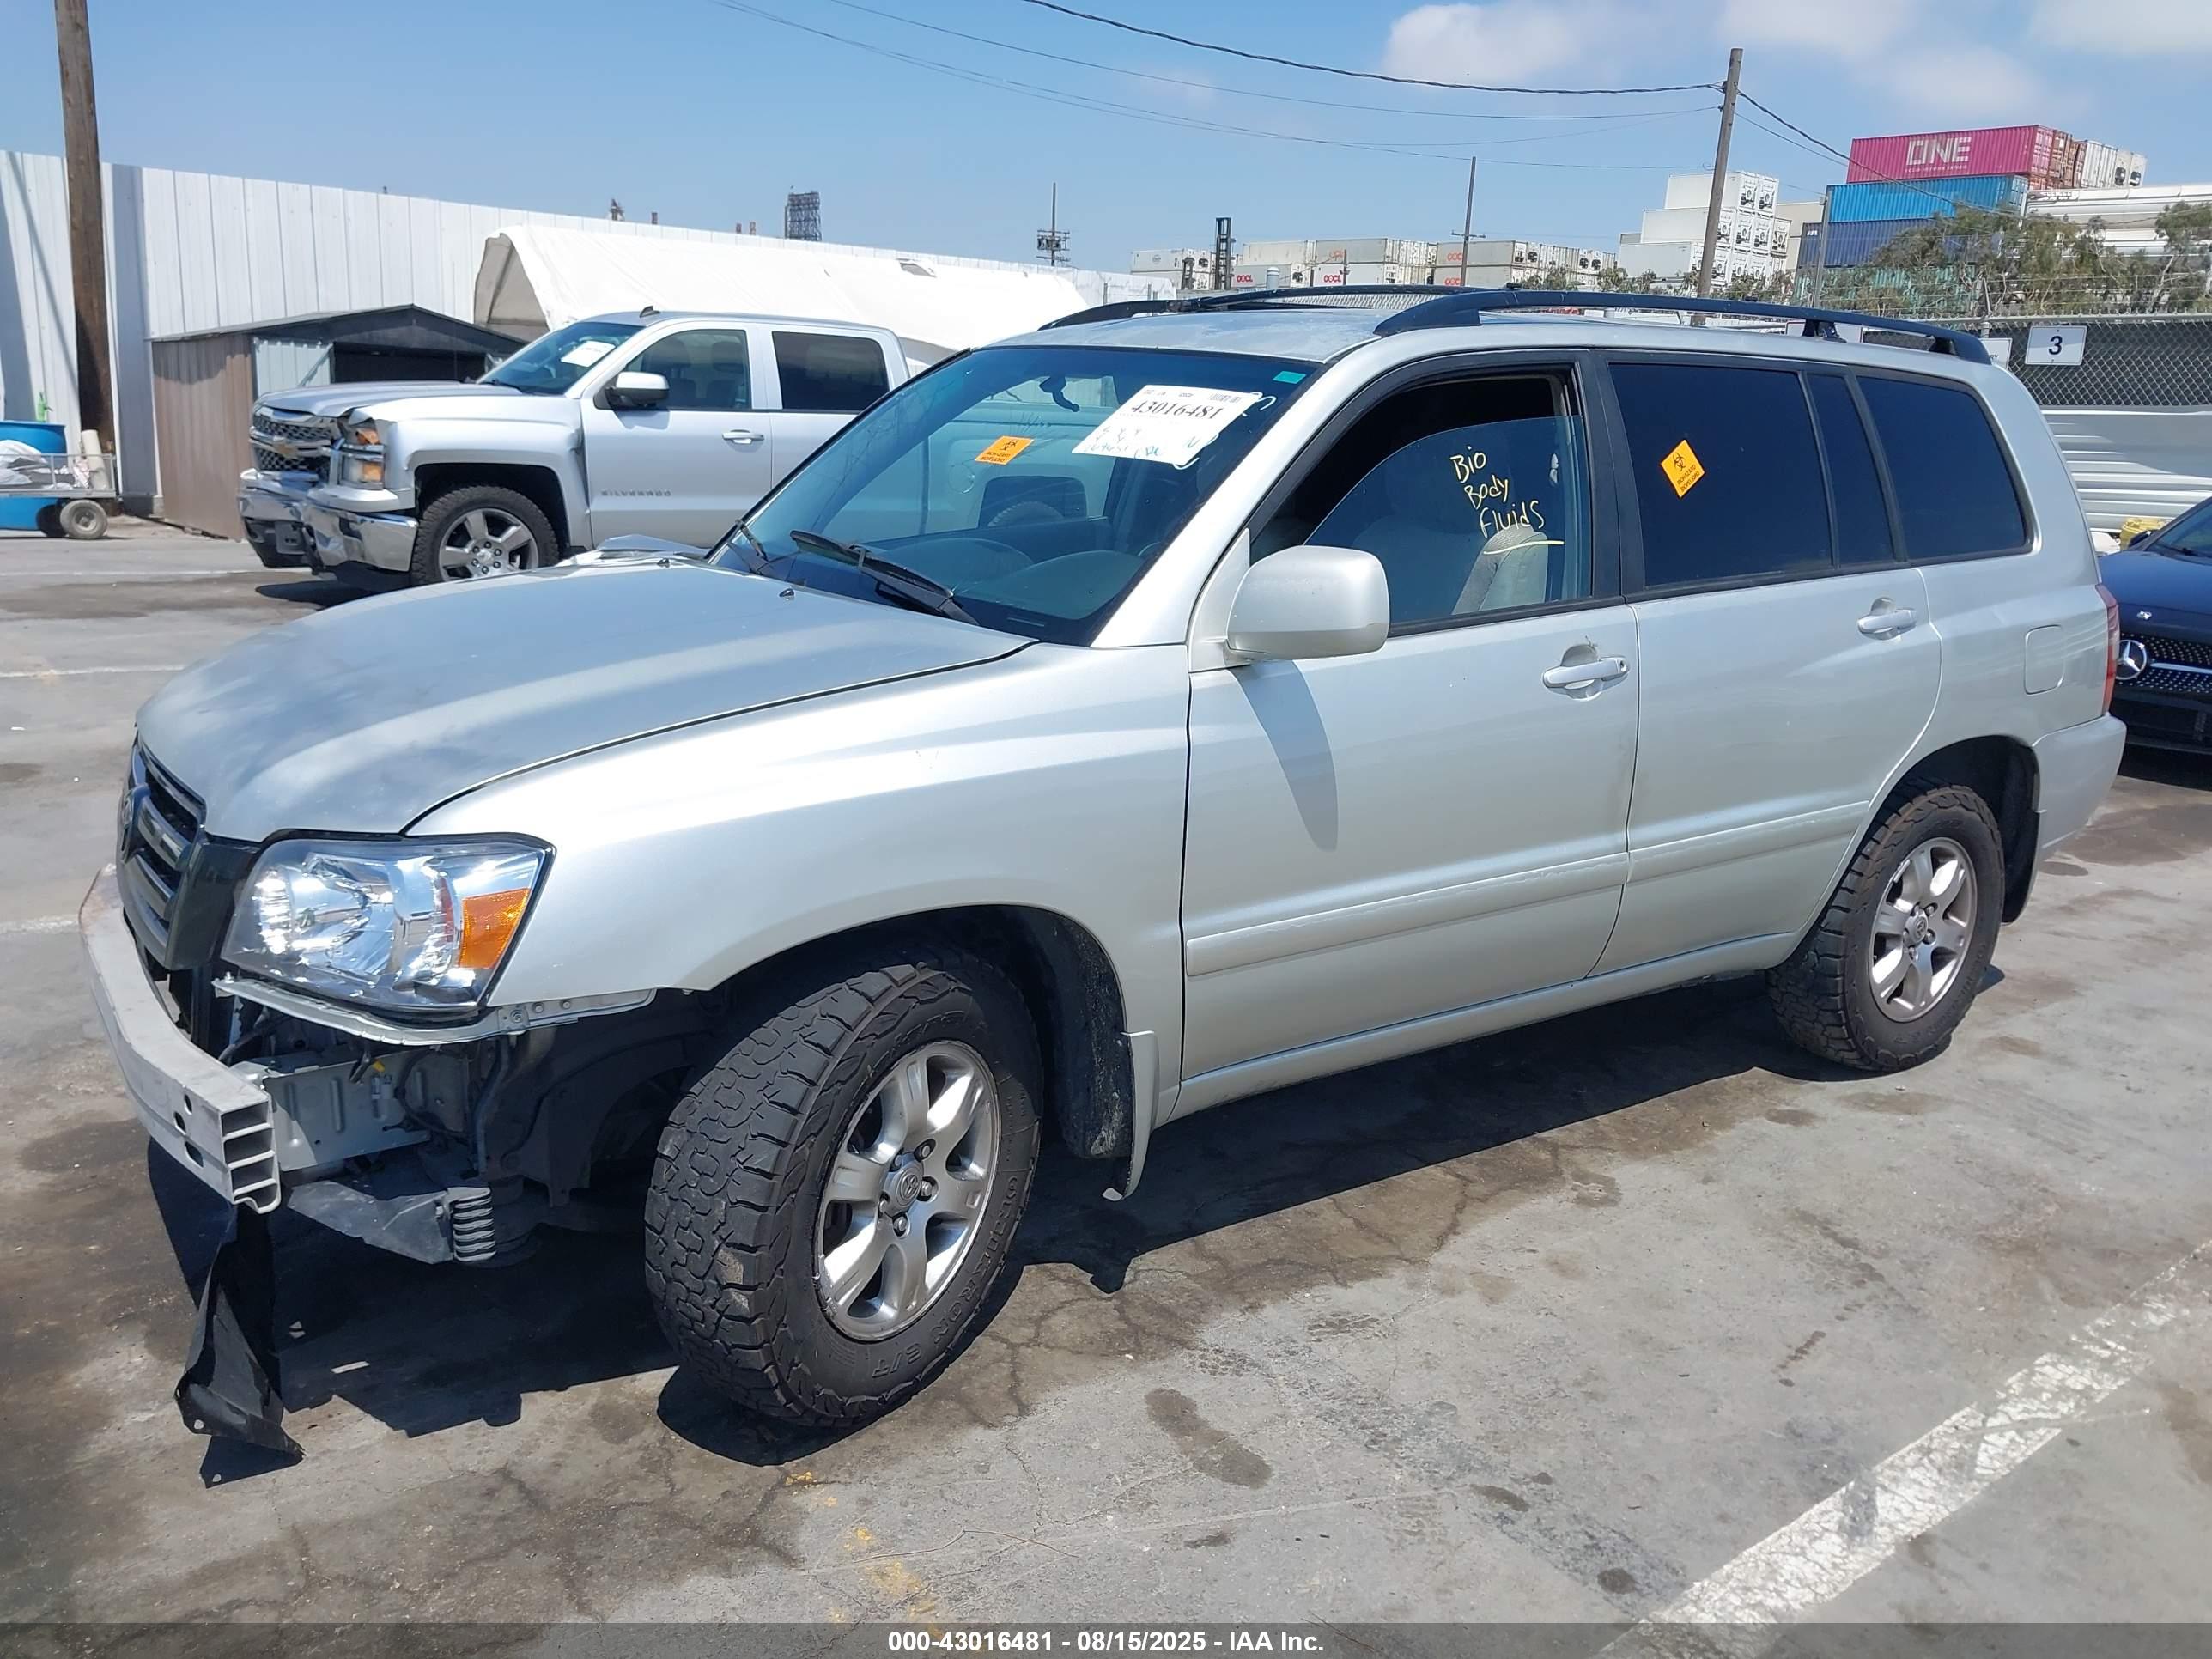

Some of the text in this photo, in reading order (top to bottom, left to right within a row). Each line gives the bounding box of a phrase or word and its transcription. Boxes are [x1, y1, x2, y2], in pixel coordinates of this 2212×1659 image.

[1905, 137, 1972, 166] ONE
[1237, 274, 1253, 283] OOCL
[1323, 274, 1342, 283] OOCL
[2048, 335, 2063, 355] 3
[1131, 400, 1224, 420] 43016481
[1449, 445, 1486, 483] Bio
[601, 488, 672, 496] SILVERADO
[1464, 474, 1509, 510] Body
